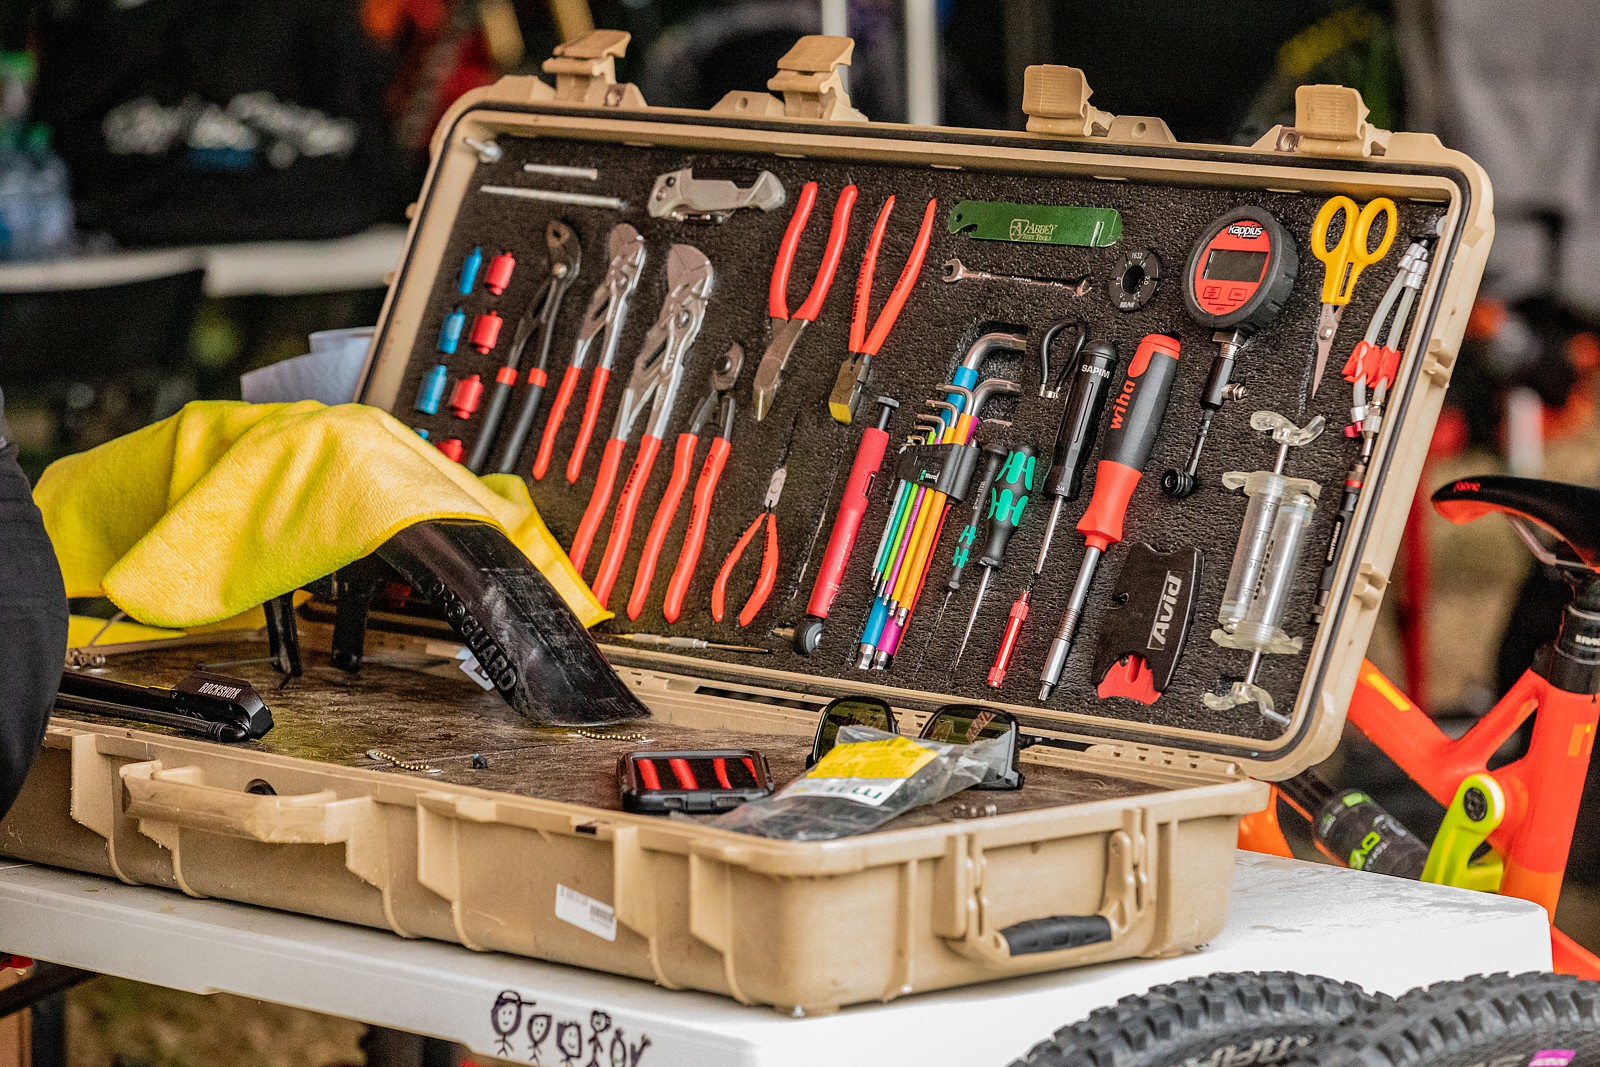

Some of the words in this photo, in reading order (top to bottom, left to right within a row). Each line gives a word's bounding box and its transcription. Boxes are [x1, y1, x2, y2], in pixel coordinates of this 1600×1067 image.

[1026, 222, 1058, 236] ABBEY
[1228, 223, 1264, 238] kappius
[1081, 364, 1110, 379] SAPIM
[1110, 380, 1136, 429] wiha
[1326, 521, 1342, 562] BONTRAGER
[198, 682, 242, 699] ROCKSHOX
